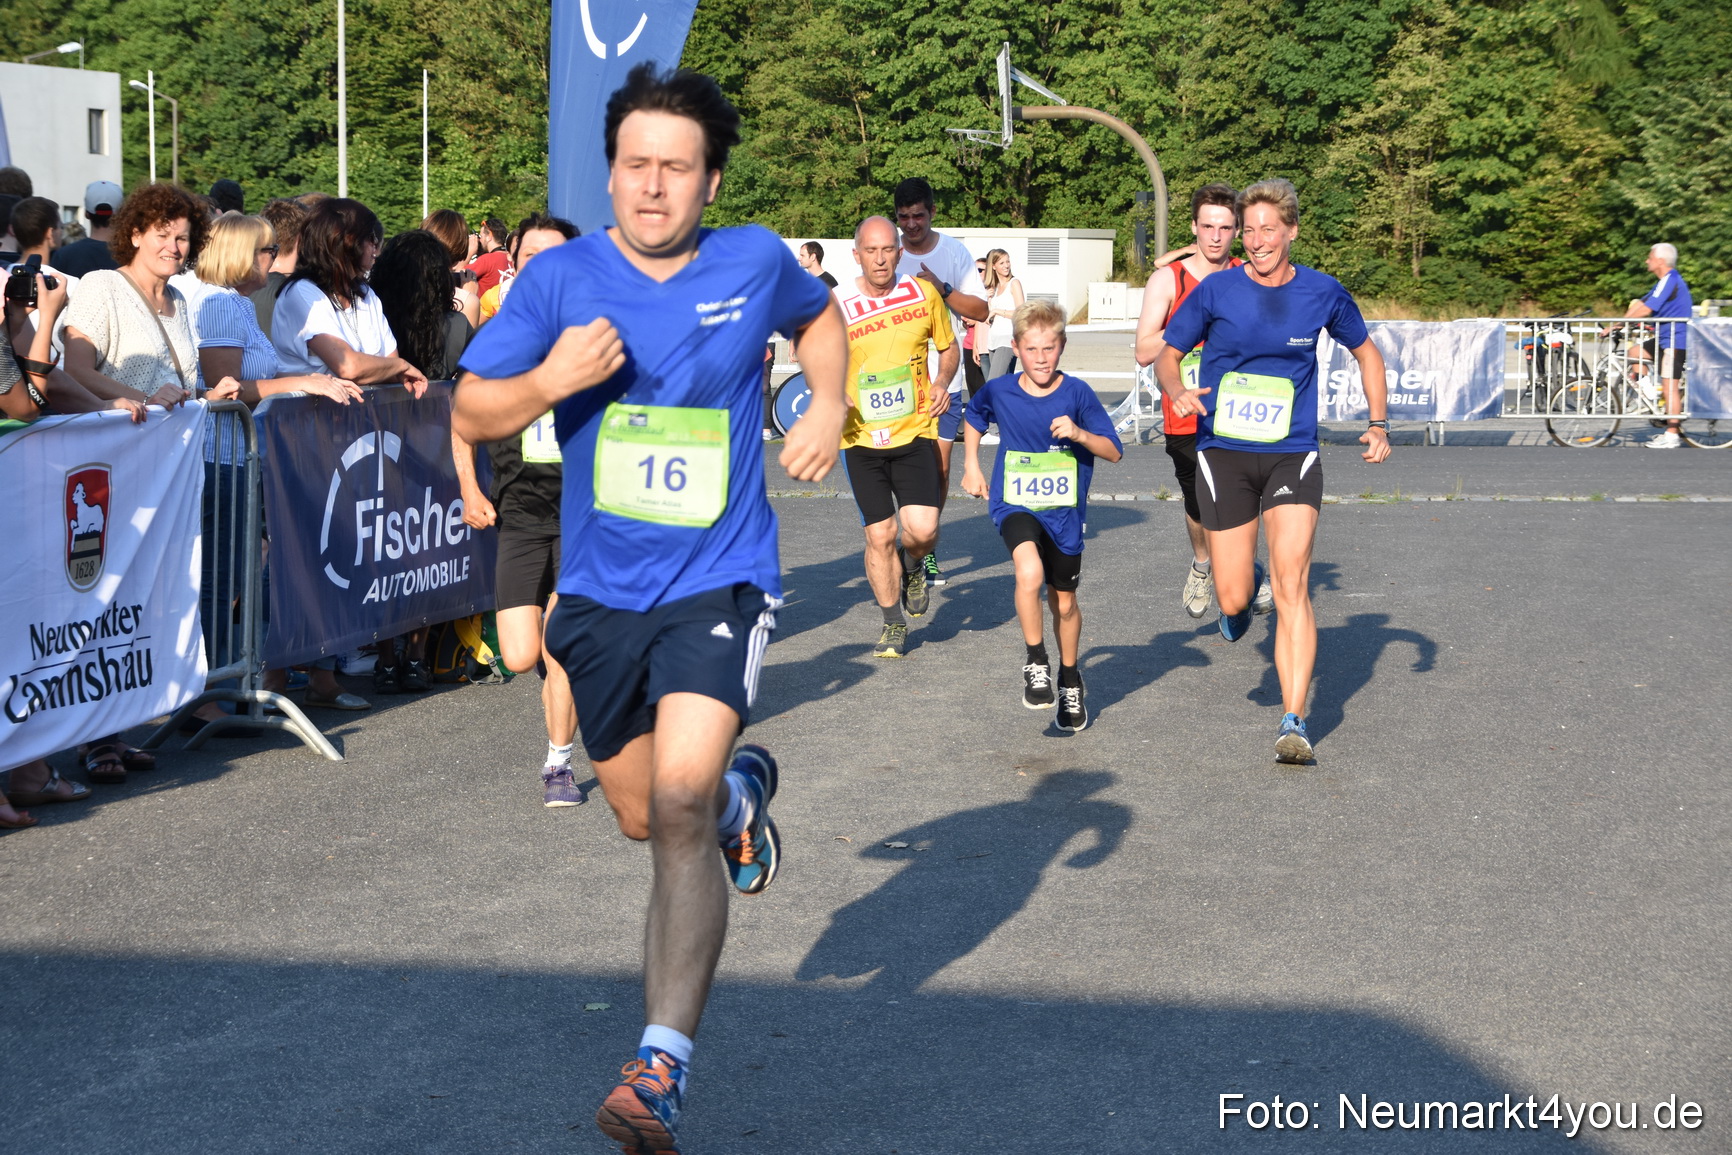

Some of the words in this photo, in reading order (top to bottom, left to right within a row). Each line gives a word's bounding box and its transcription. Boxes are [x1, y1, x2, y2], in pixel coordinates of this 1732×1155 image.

[849, 319, 888, 341] MAX
[891, 307, 929, 325] BÖGL
[27, 382, 46, 405] SONY
[870, 387, 905, 409] 884
[1225, 399, 1284, 424] 1497
[638, 455, 687, 492] 16
[1012, 476, 1069, 496] 1498
[75, 560, 95, 580] 1628
[362, 555, 470, 605] AUTOMOBILE
[29, 600, 143, 661] Neumrkter
